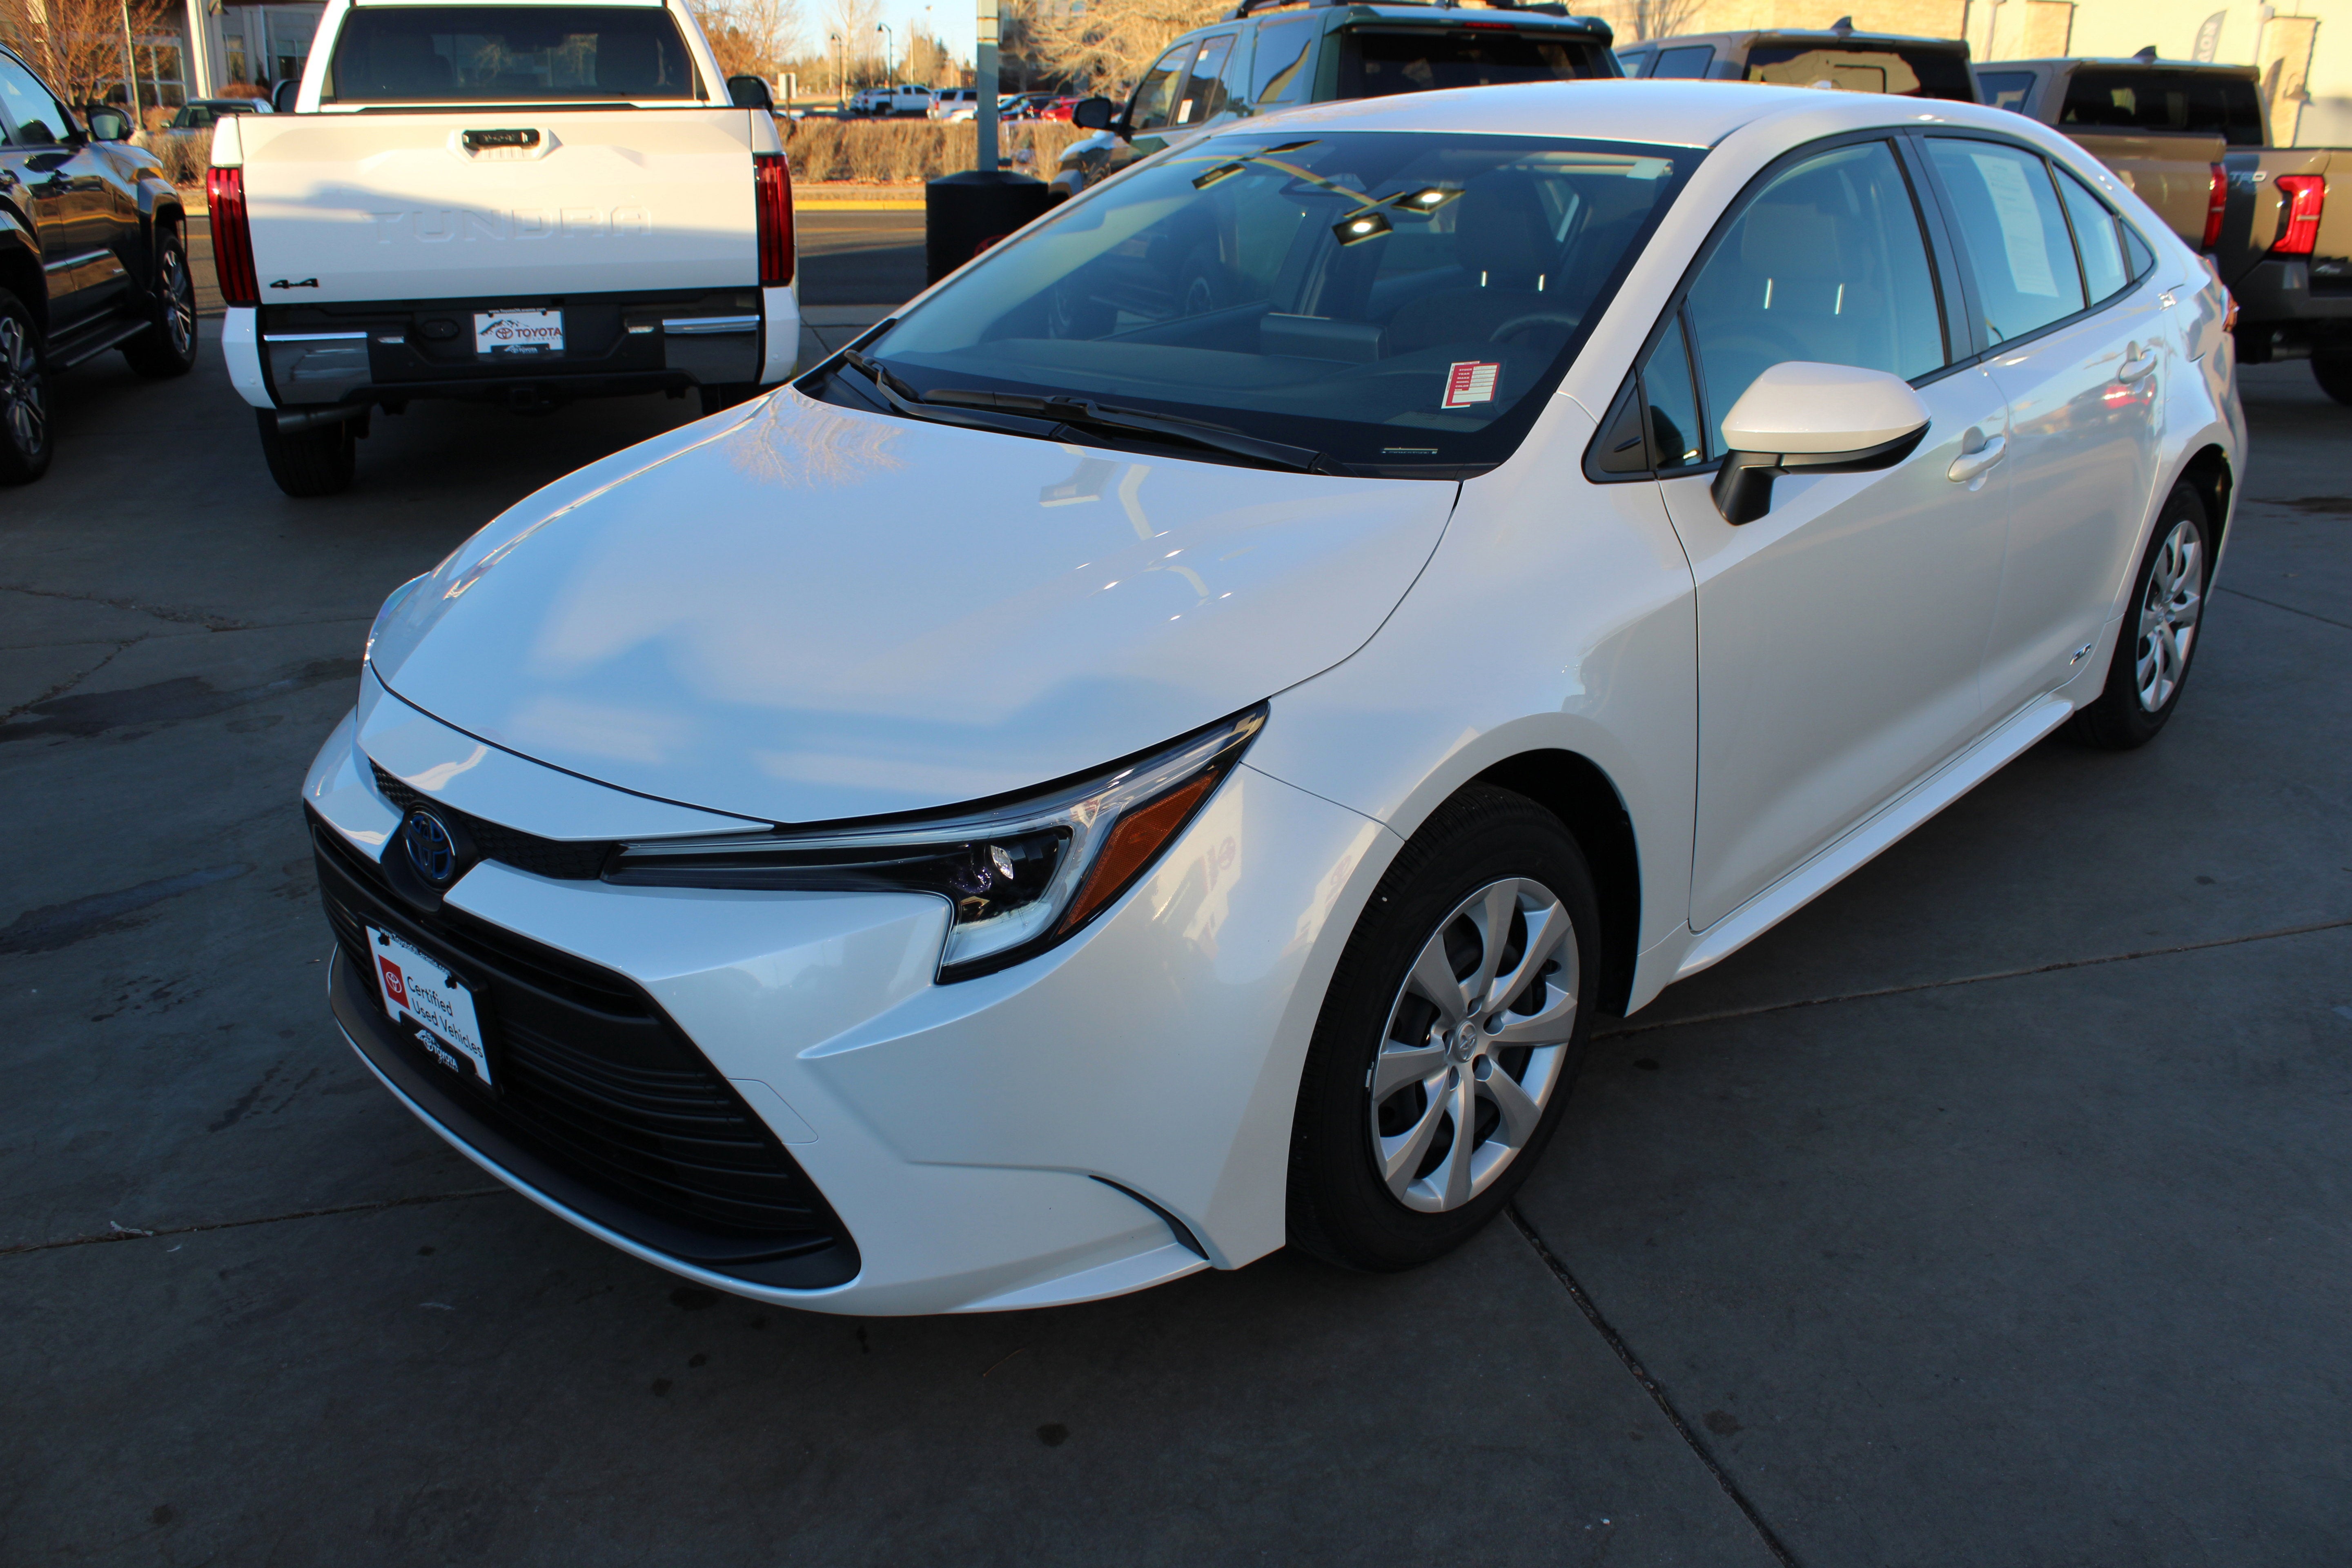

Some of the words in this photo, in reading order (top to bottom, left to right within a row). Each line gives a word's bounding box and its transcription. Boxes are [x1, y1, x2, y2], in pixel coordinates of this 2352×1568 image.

[361, 206, 652, 244] TUNDRA
[516, 327, 563, 338] TOYOTA
[407, 976, 453, 1017] Certified
[412, 998, 439, 1027] Used
[439, 1016, 483, 1058] Vehicles
[433, 1045, 457, 1067] TOYOTA
